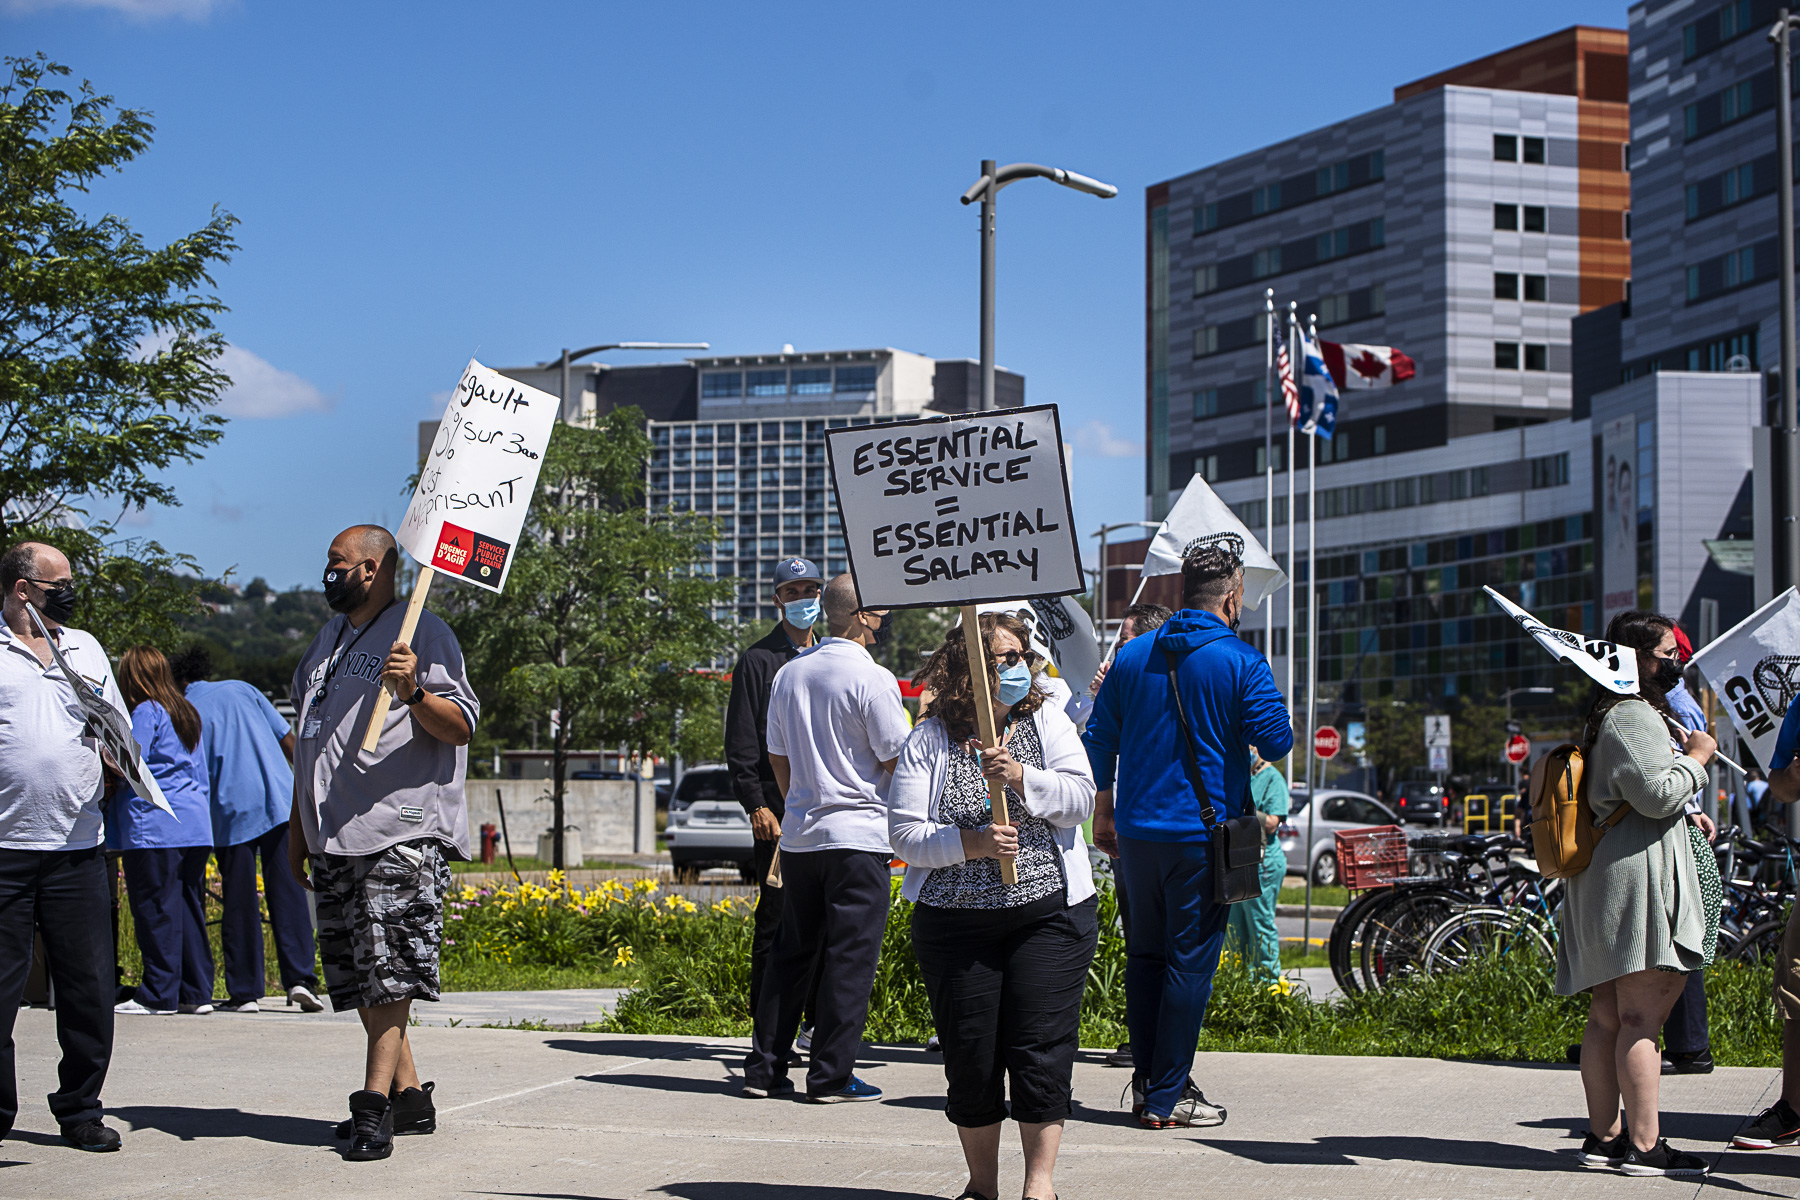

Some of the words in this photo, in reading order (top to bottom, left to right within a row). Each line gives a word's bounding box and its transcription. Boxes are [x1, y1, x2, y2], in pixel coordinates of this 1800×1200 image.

[464, 421, 503, 444] sur
[436, 548, 465, 567] D'AGIR
[439, 541, 468, 558] URGENCE
[475, 547, 504, 564] PUBLICS
[478, 540, 506, 556] SERVICES
[902, 547, 1039, 586] SALARY
[1725, 675, 1776, 740] CSN
